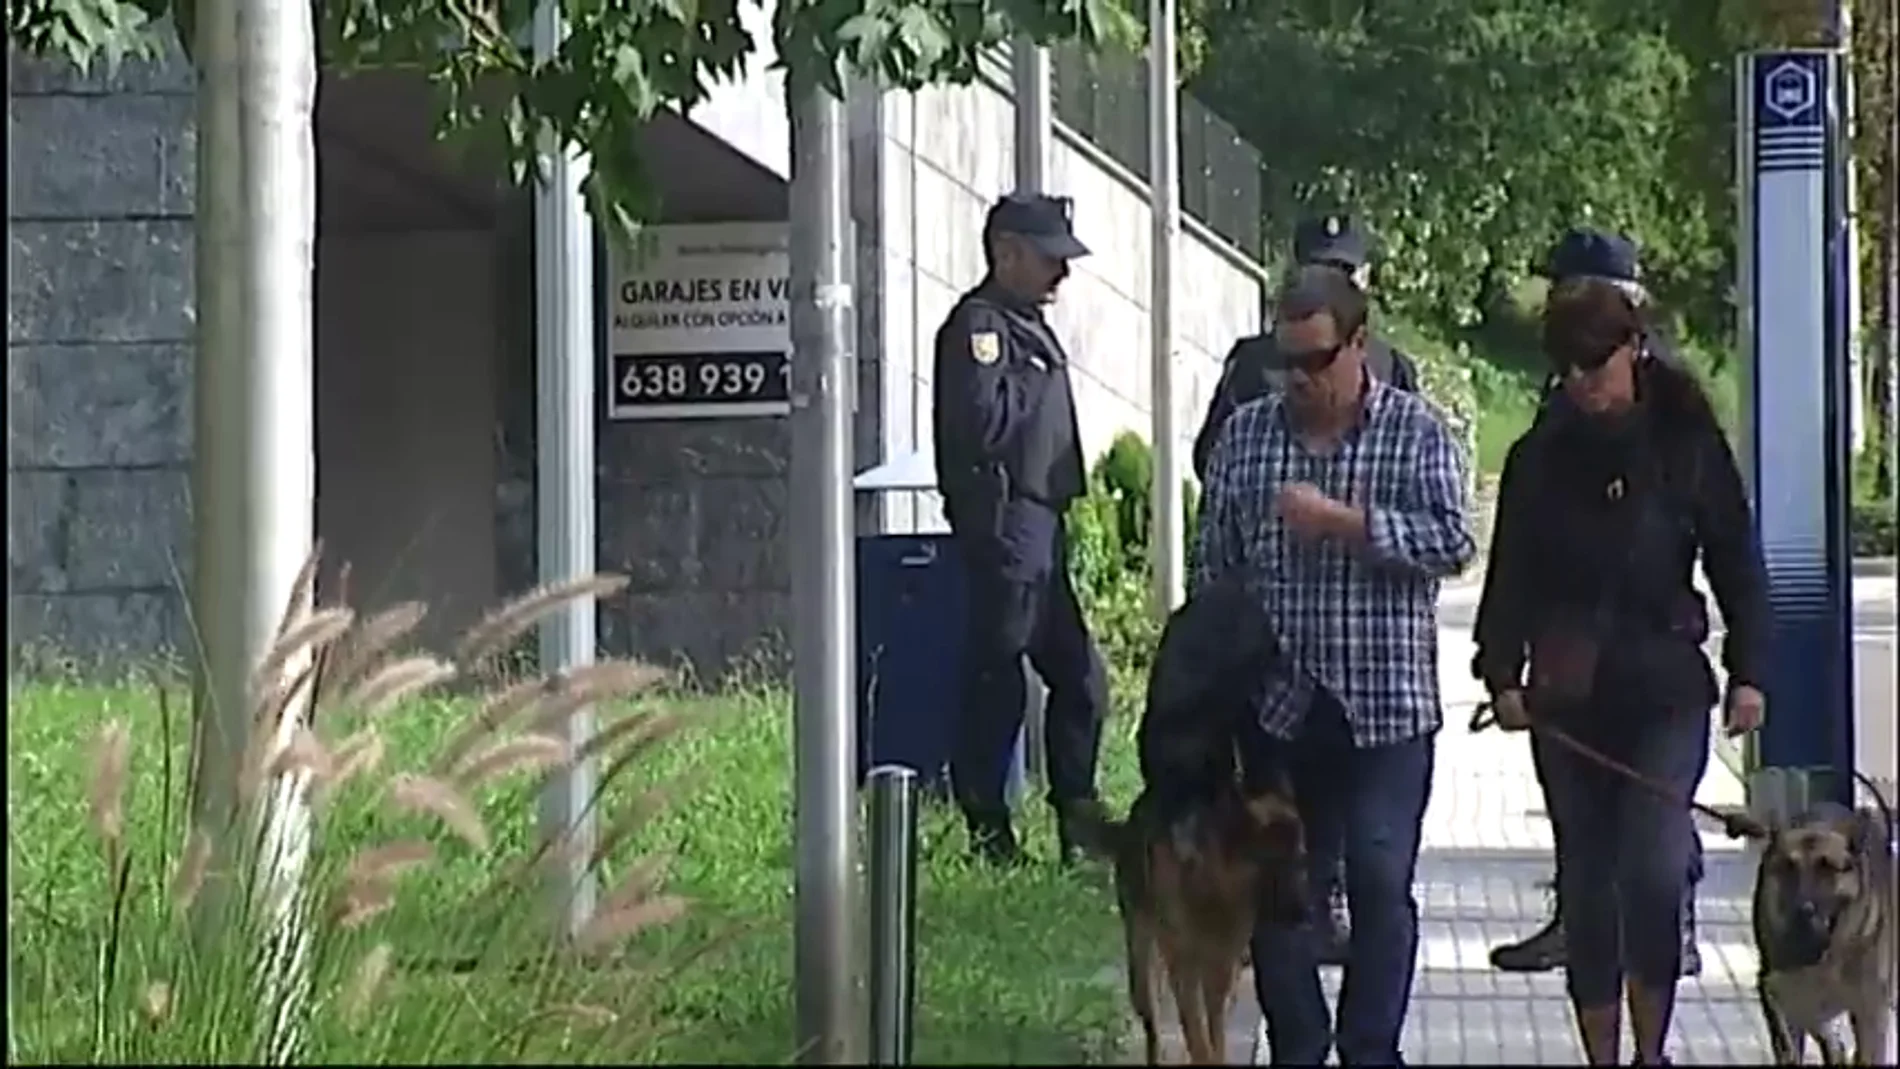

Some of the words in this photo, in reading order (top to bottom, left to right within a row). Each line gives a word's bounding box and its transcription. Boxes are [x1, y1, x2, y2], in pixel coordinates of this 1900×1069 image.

[621, 278, 722, 304] GARAJES
[728, 278, 761, 301] EN
[621, 364, 687, 397] 638
[699, 362, 766, 396] 939
